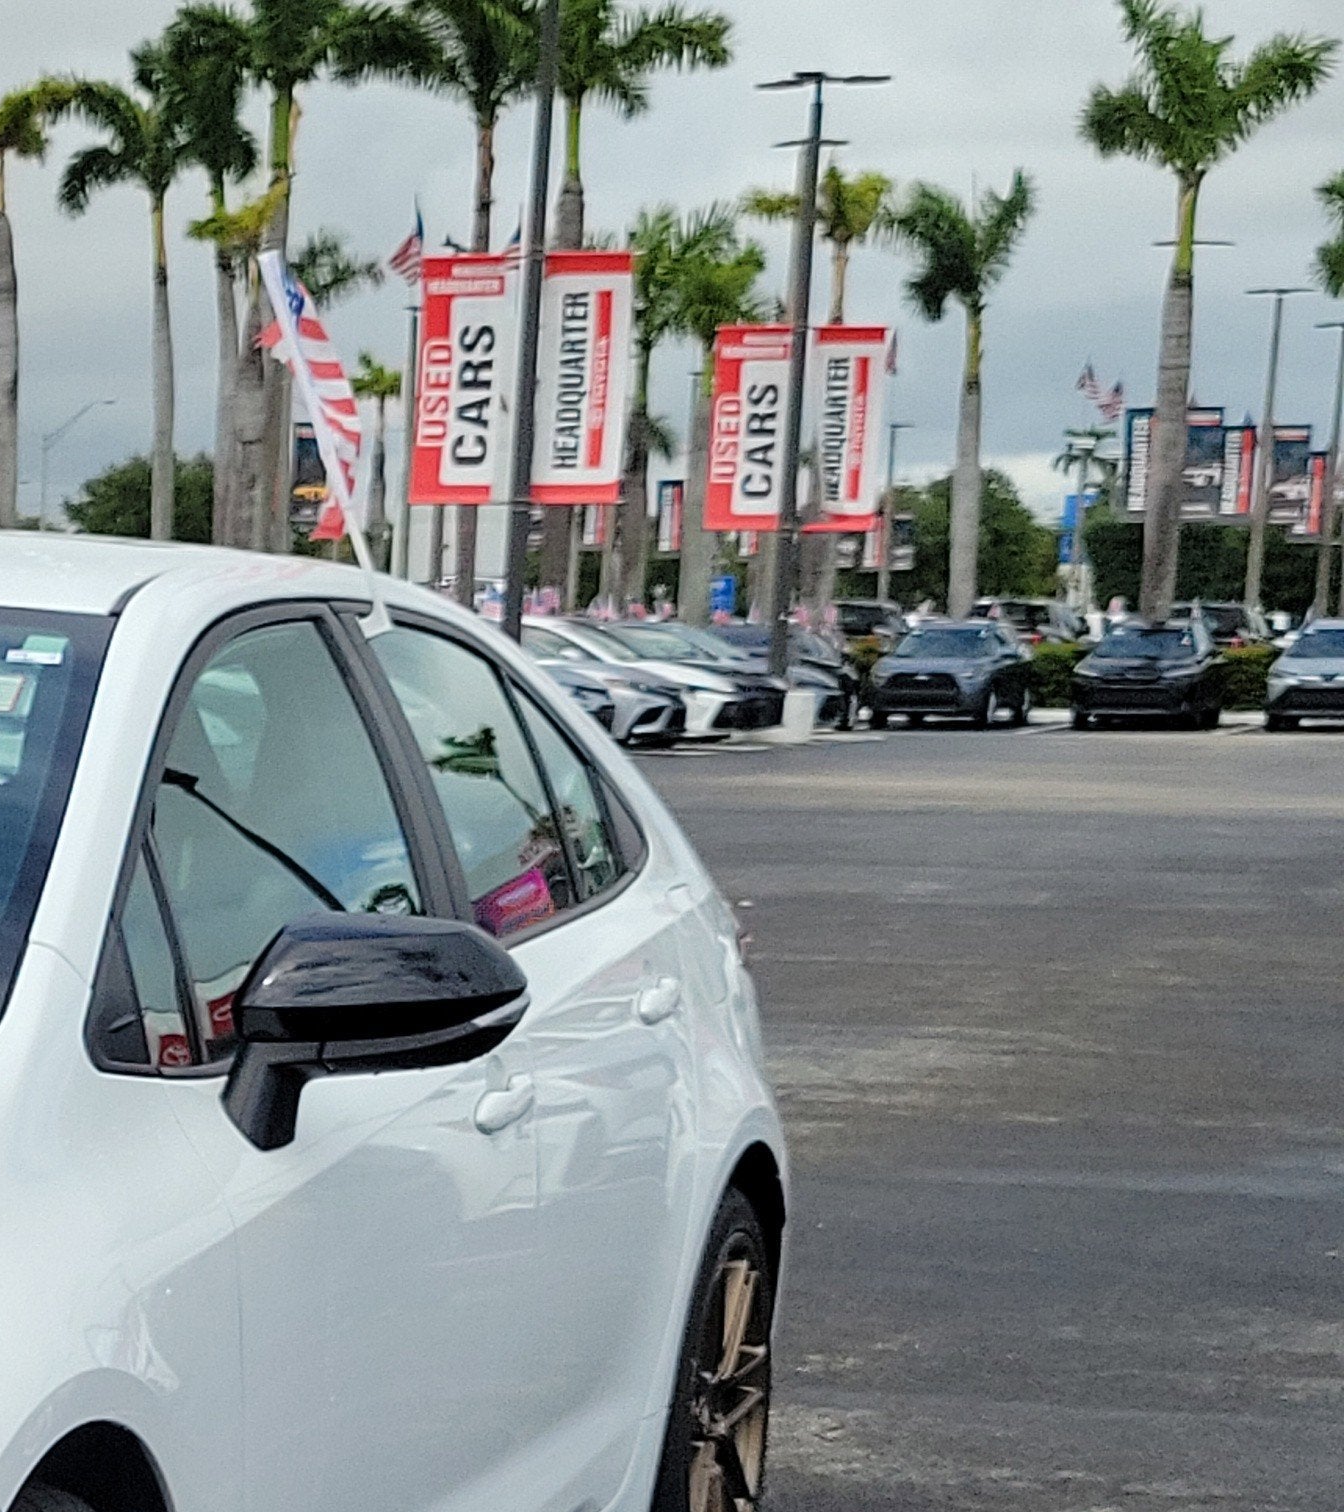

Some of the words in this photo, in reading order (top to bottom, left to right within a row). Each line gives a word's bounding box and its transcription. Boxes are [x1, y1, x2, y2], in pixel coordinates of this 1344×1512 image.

[422, 342, 452, 441] USED
[452, 324, 496, 467] CARS
[552, 291, 590, 470] HEADQUARTER
[713, 399, 741, 479] USED
[741, 383, 779, 498] CARS
[822, 356, 850, 501] HEADQUARTER
